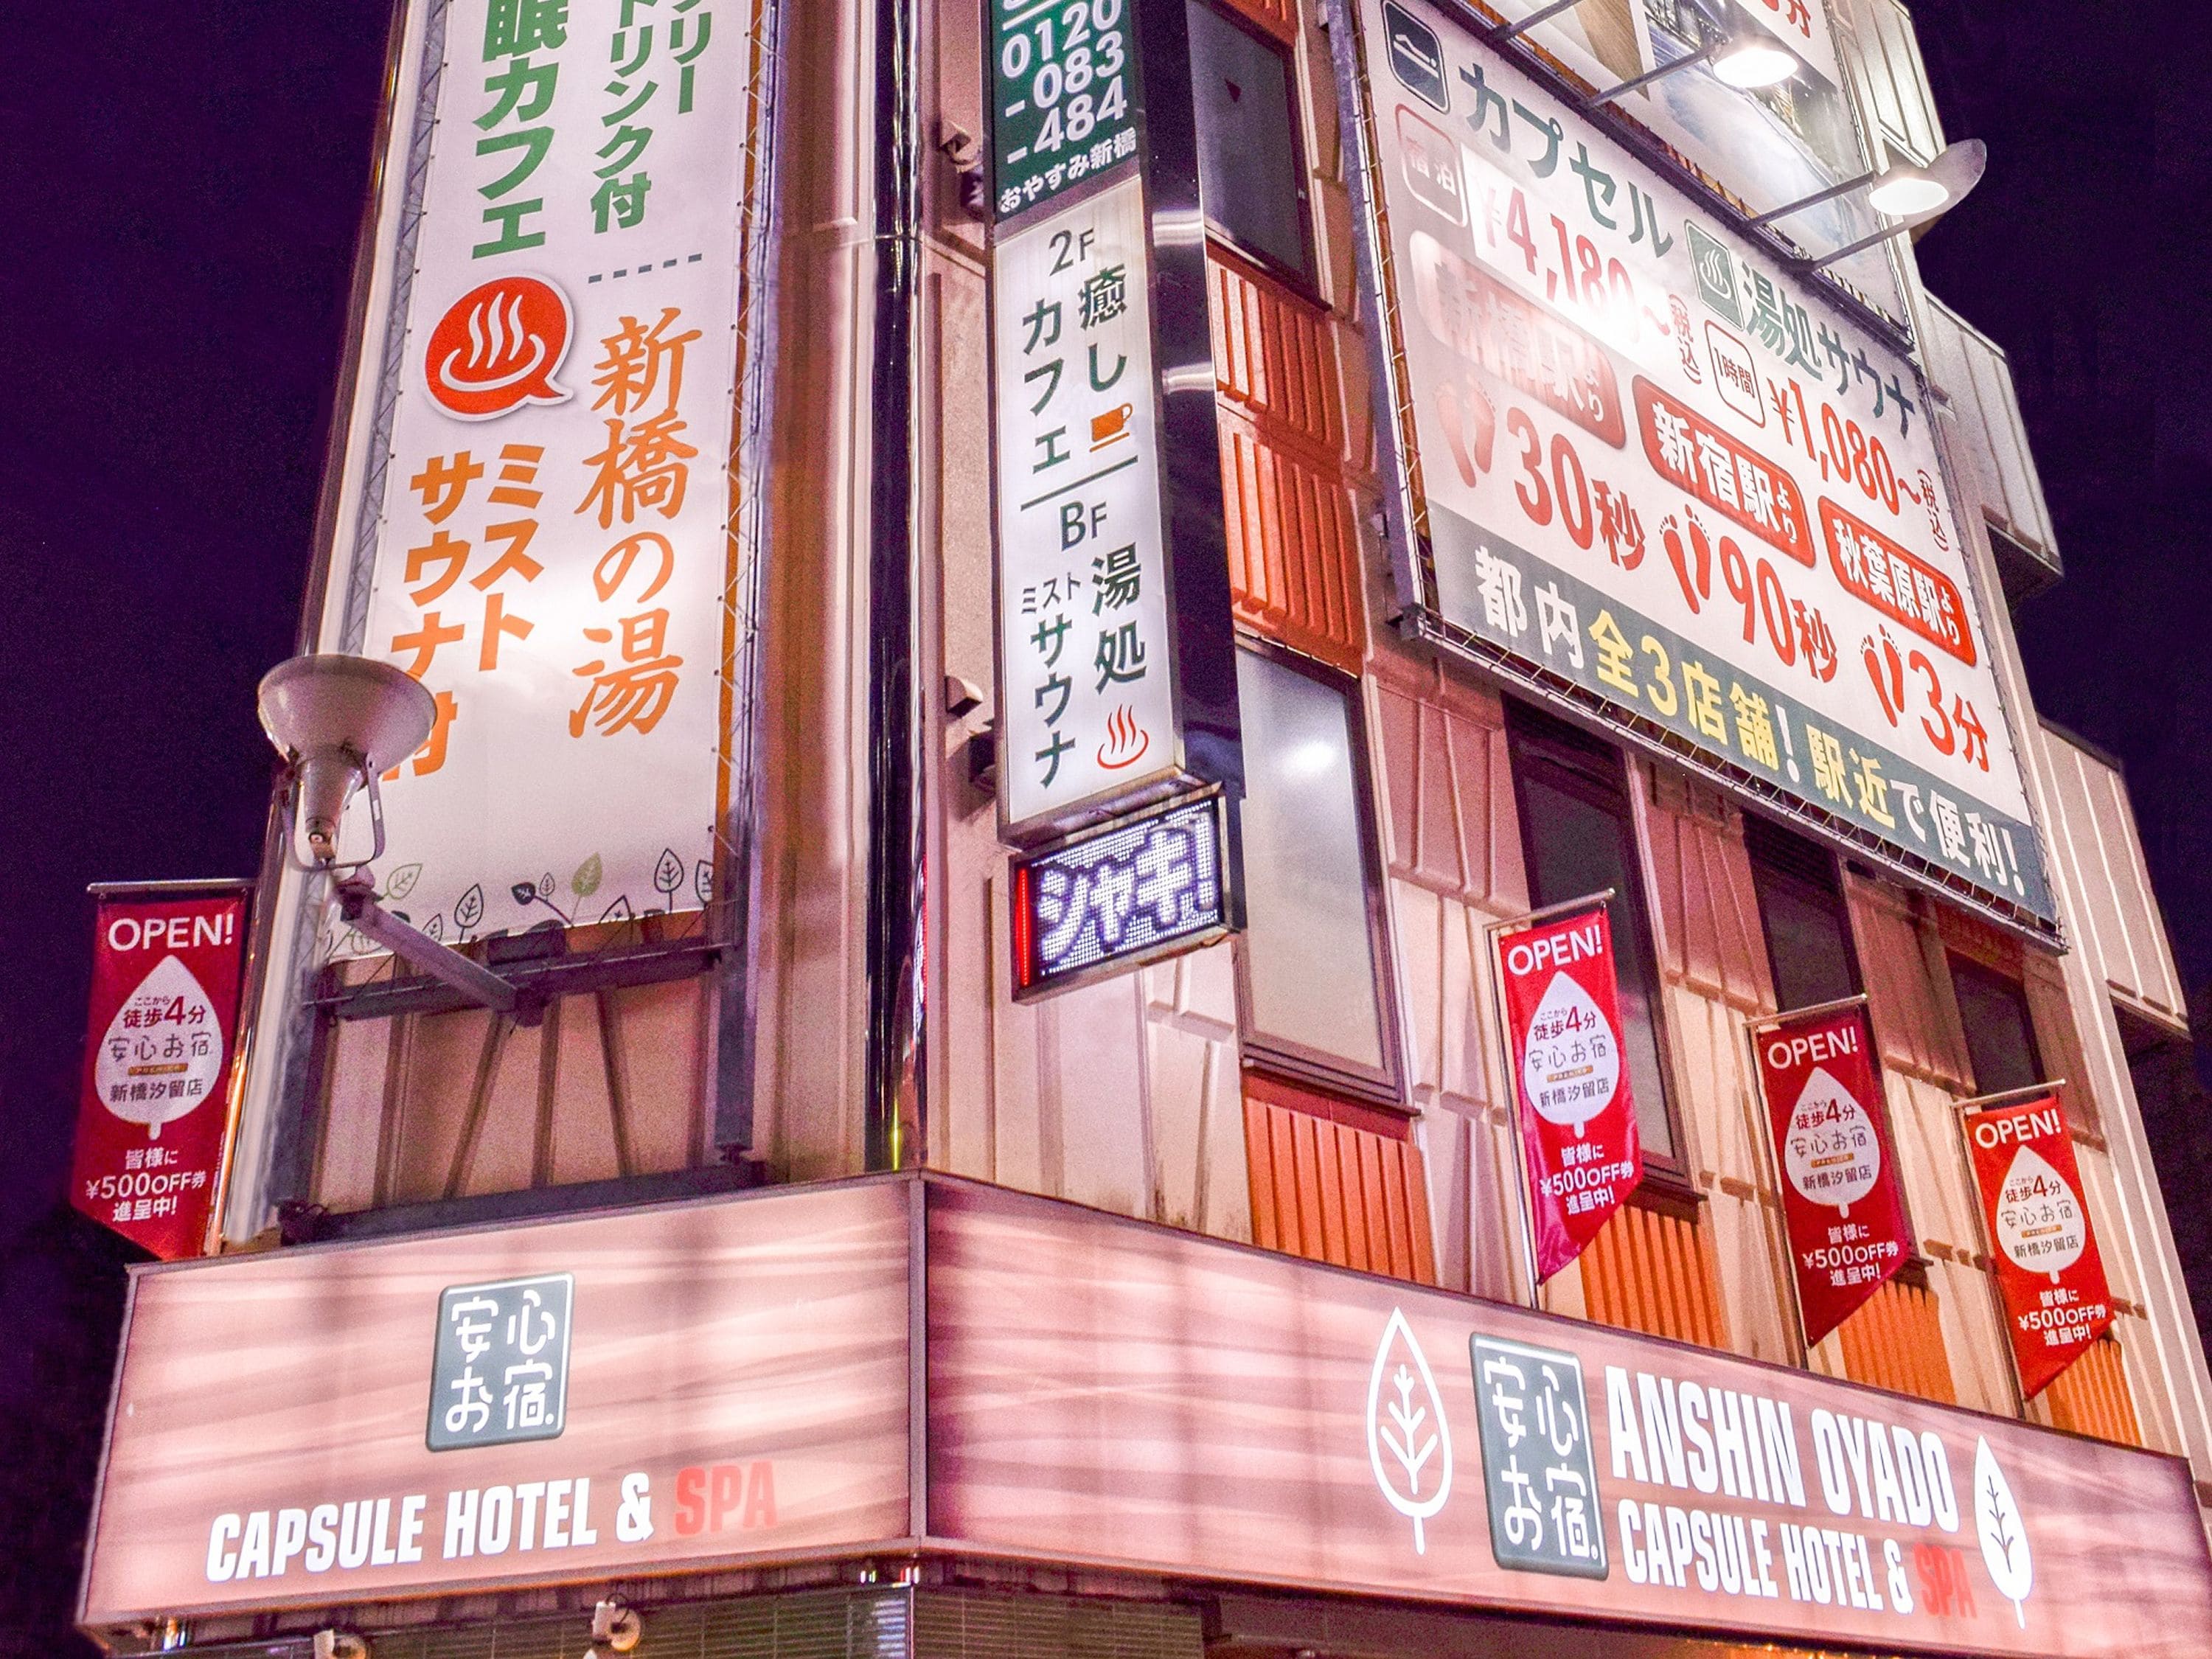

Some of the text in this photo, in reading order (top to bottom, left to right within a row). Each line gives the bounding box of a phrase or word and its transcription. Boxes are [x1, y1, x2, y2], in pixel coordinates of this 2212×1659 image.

[669, 0, 712, 114] リー
[1001, 0, 1122, 79] 0120
[1000, 127, 1137, 213] おやすみ新橋
[1458, 63, 1674, 258] カプセル
[1048, 227, 1094, 276] 2F
[1077, 262, 1128, 393] 癒し
[1742, 262, 1916, 439] 湯処サウナ
[1021, 297, 1071, 474] カフェ
[568, 307, 703, 739] 新橋の湯
[1060, 499, 1107, 552] BF
[1506, 406, 1646, 571] 30秒
[469, 444, 544, 671] ミスト
[1021, 571, 1082, 614] ミスト
[1091, 542, 1147, 696] 湯処
[1719, 535, 1838, 684] 90秒
[1030, 613, 1077, 789] サウナ
[1908, 649, 1990, 773] 3分
[108, 913, 234, 953] OPEN!
[1507, 924, 1604, 976] OPEN!
[108, 1032, 212, 1062] 安心お宿
[123, 995, 207, 1029] 徒歩4分
[1534, 1006, 1596, 1042] 徒歩4分
[1767, 1026, 1860, 1070] OPEN!
[1528, 1034, 1607, 1072] 安心お宿
[1796, 1098, 1856, 1130] 徒歩4分
[1974, 1107, 2062, 1150] OPEN!
[125, 1148, 178, 1170] 皆様に
[1560, 1142, 1604, 1167] 皆様に
[2005, 1175, 2062, 1203] 徒歩4分
[1827, 1222, 1871, 1246] 皆様に
[451, 1289, 556, 1363] 安心
[1484, 1356, 1579, 1456] 安心
[1603, 1365, 1961, 1534] ANSHIN OYADO
[206, 1460, 779, 1585] CAPSULE HOTEL & SPA
[1617, 1498, 1978, 1621] CAPSULE HOTEL & SPA
